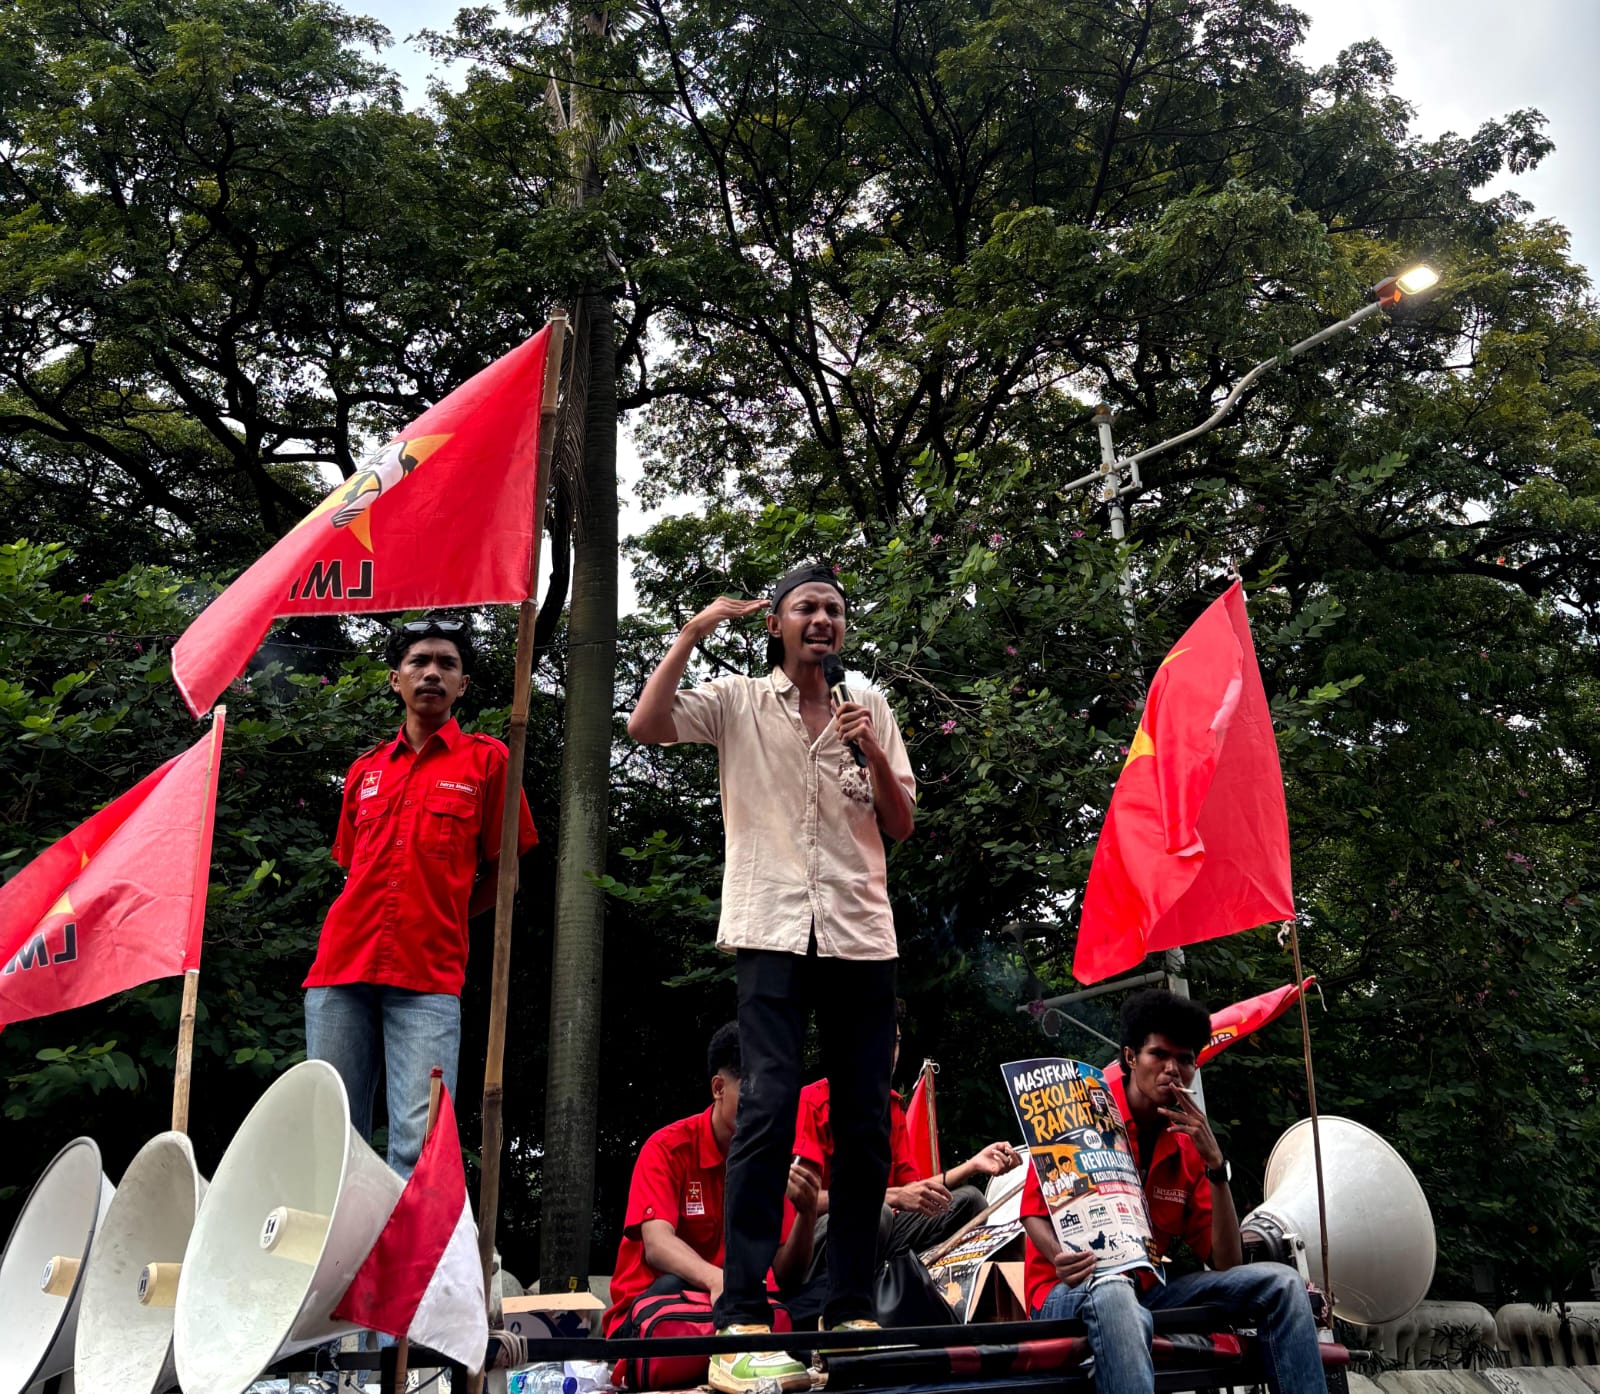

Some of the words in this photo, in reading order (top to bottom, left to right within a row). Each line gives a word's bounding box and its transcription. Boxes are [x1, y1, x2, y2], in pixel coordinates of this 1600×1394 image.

[1013, 1060, 1077, 1095] MASIFKAN
[1019, 1080, 1088, 1120] SEKOLAH
[1031, 1102, 1094, 1143] RAKYAT
[1086, 1133, 1101, 1145] DAN
